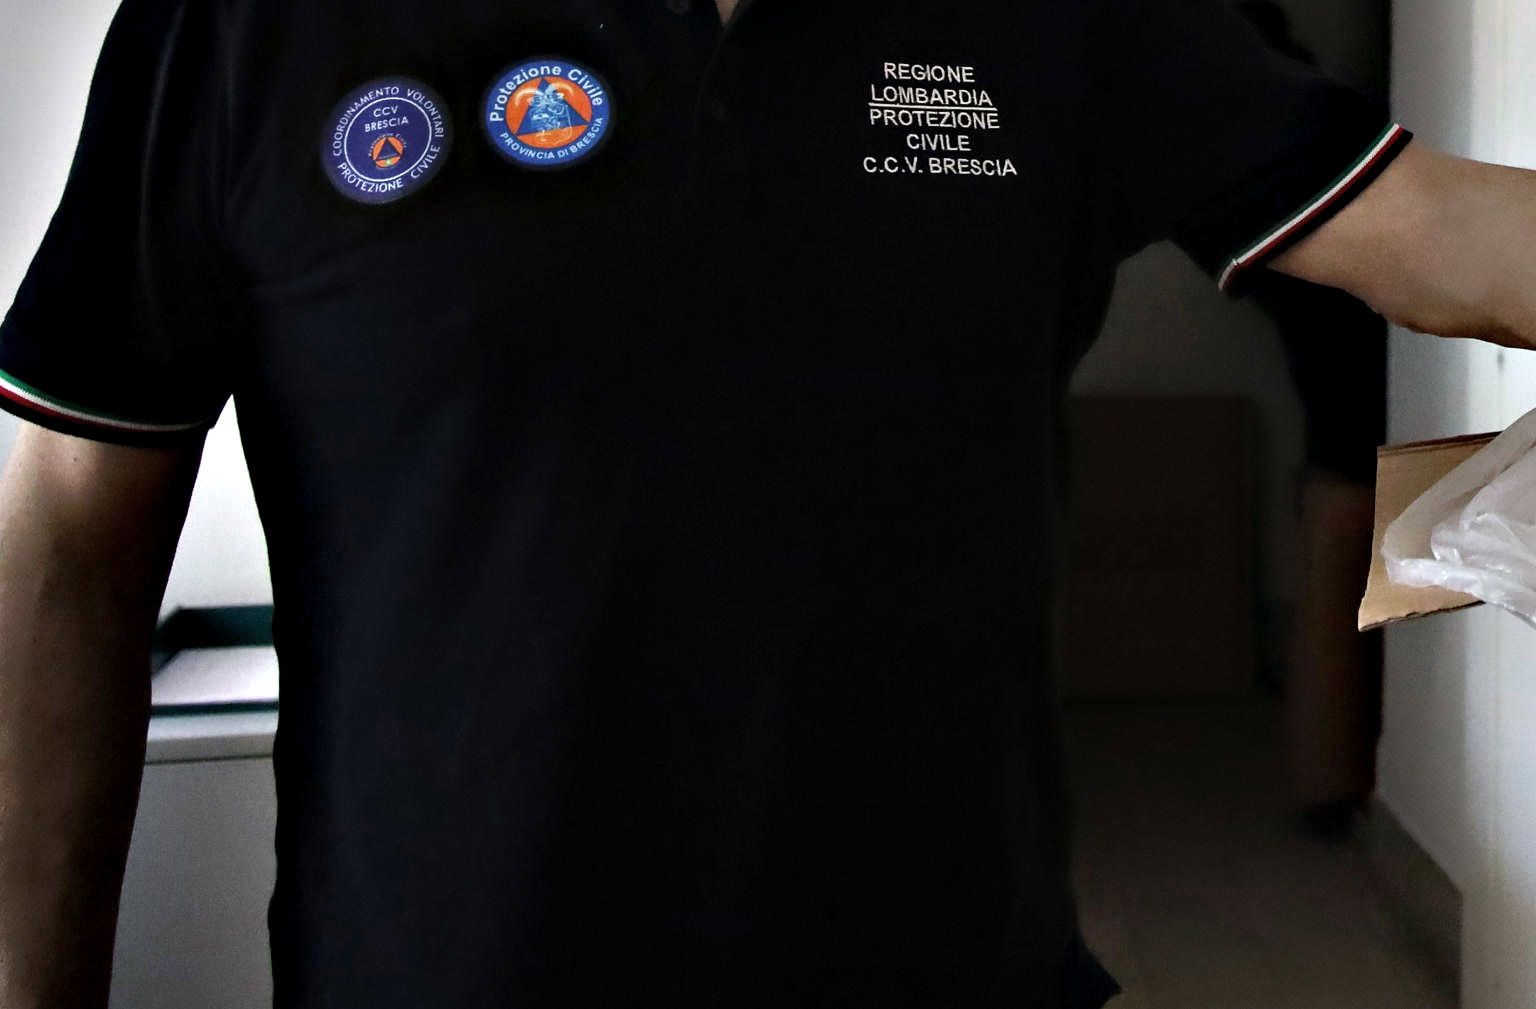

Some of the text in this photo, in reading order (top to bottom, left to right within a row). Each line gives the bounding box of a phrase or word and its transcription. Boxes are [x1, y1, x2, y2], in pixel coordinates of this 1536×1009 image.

[883, 61, 976, 84] REGIONE
[489, 65, 604, 122] Protezione Civile
[870, 83, 994, 107] LOMBARDIA
[332, 85, 401, 158] COORDINAMENTO
[406, 87, 445, 138] VOLONTARI
[372, 104, 399, 118] CCV
[869, 108, 1001, 130] PROTEZIONE
[364, 116, 409, 133] BRESCIA
[500, 117, 604, 160] PROVINCIA DI BRESCIA
[906, 133, 972, 152] CIVILE
[337, 162, 405, 193] PROTEZIONE
[410, 144, 441, 180] CIVILE
[863, 156, 1018, 177] C.C.V. BRESCIA
